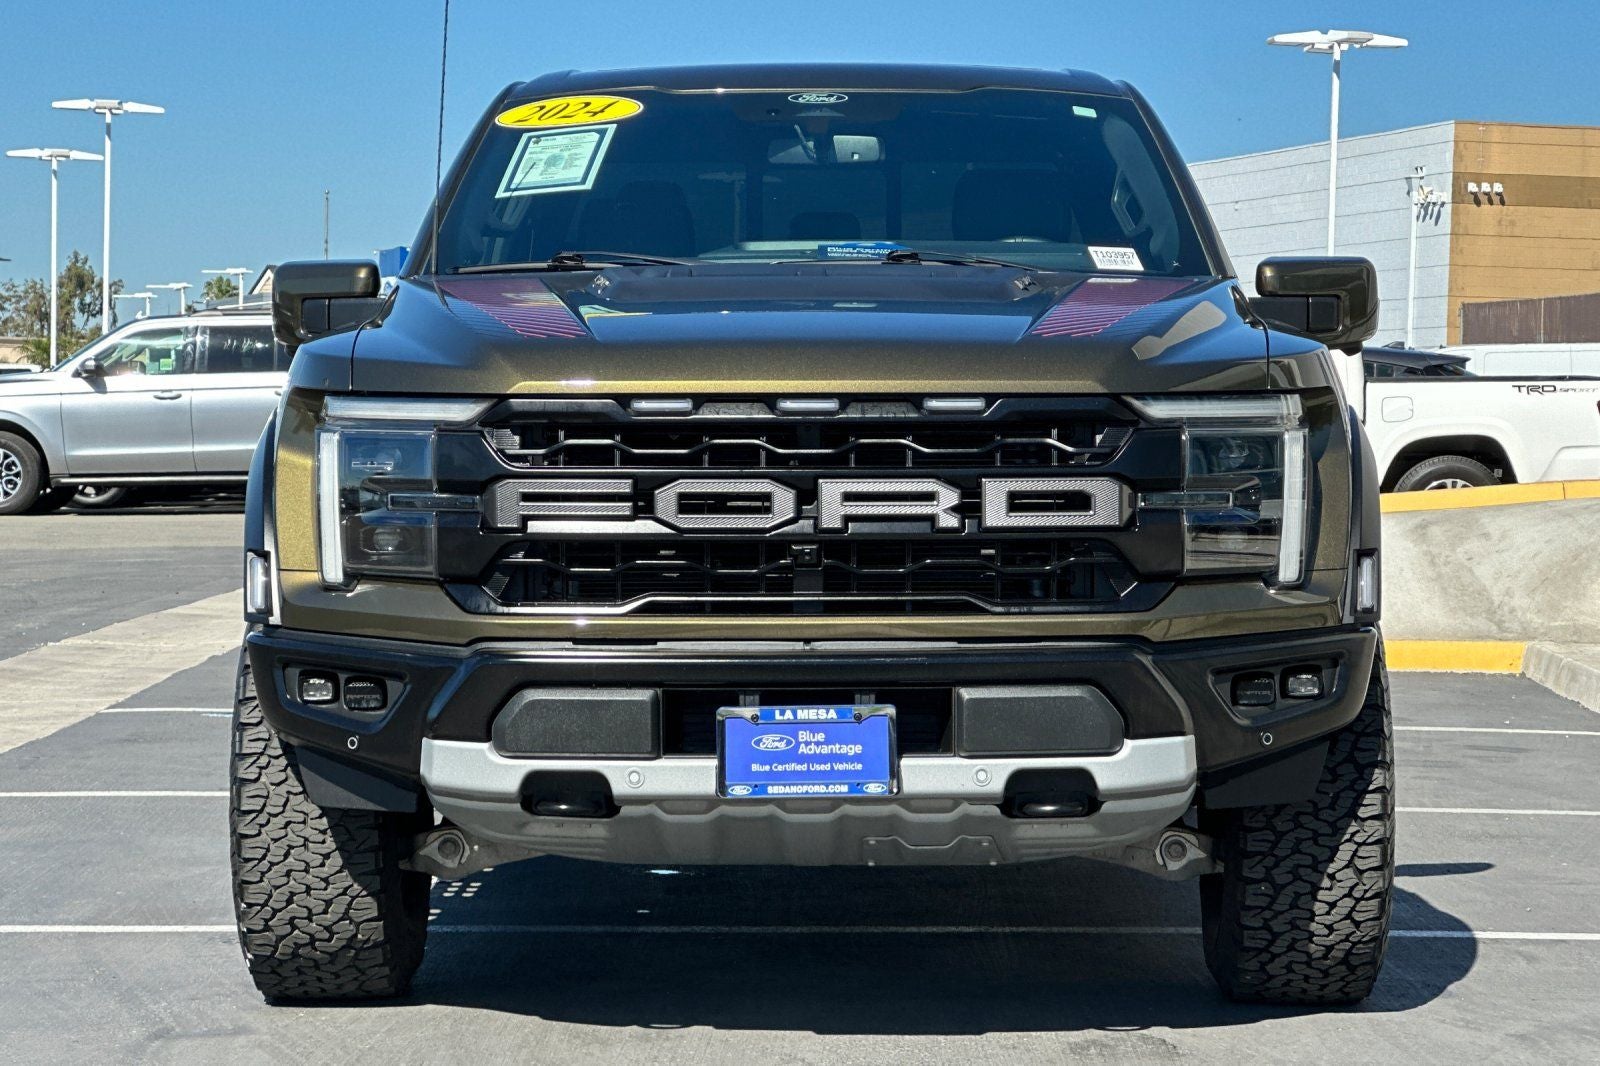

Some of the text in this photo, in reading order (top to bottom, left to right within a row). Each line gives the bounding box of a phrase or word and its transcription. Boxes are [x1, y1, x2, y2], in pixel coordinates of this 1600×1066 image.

[512, 100, 620, 123] 2024
[1511, 384, 1557, 395] TRD
[492, 478, 1127, 532] FORD
[774, 709, 837, 720] LA MESA
[798, 731, 826, 742] Blue
[758, 735, 788, 750] Ford
[798, 743, 863, 756] Advantage
[751, 762, 863, 772] Blue Certified Used Vehicle
[767, 784, 849, 794] SEDANOFORD.COM
